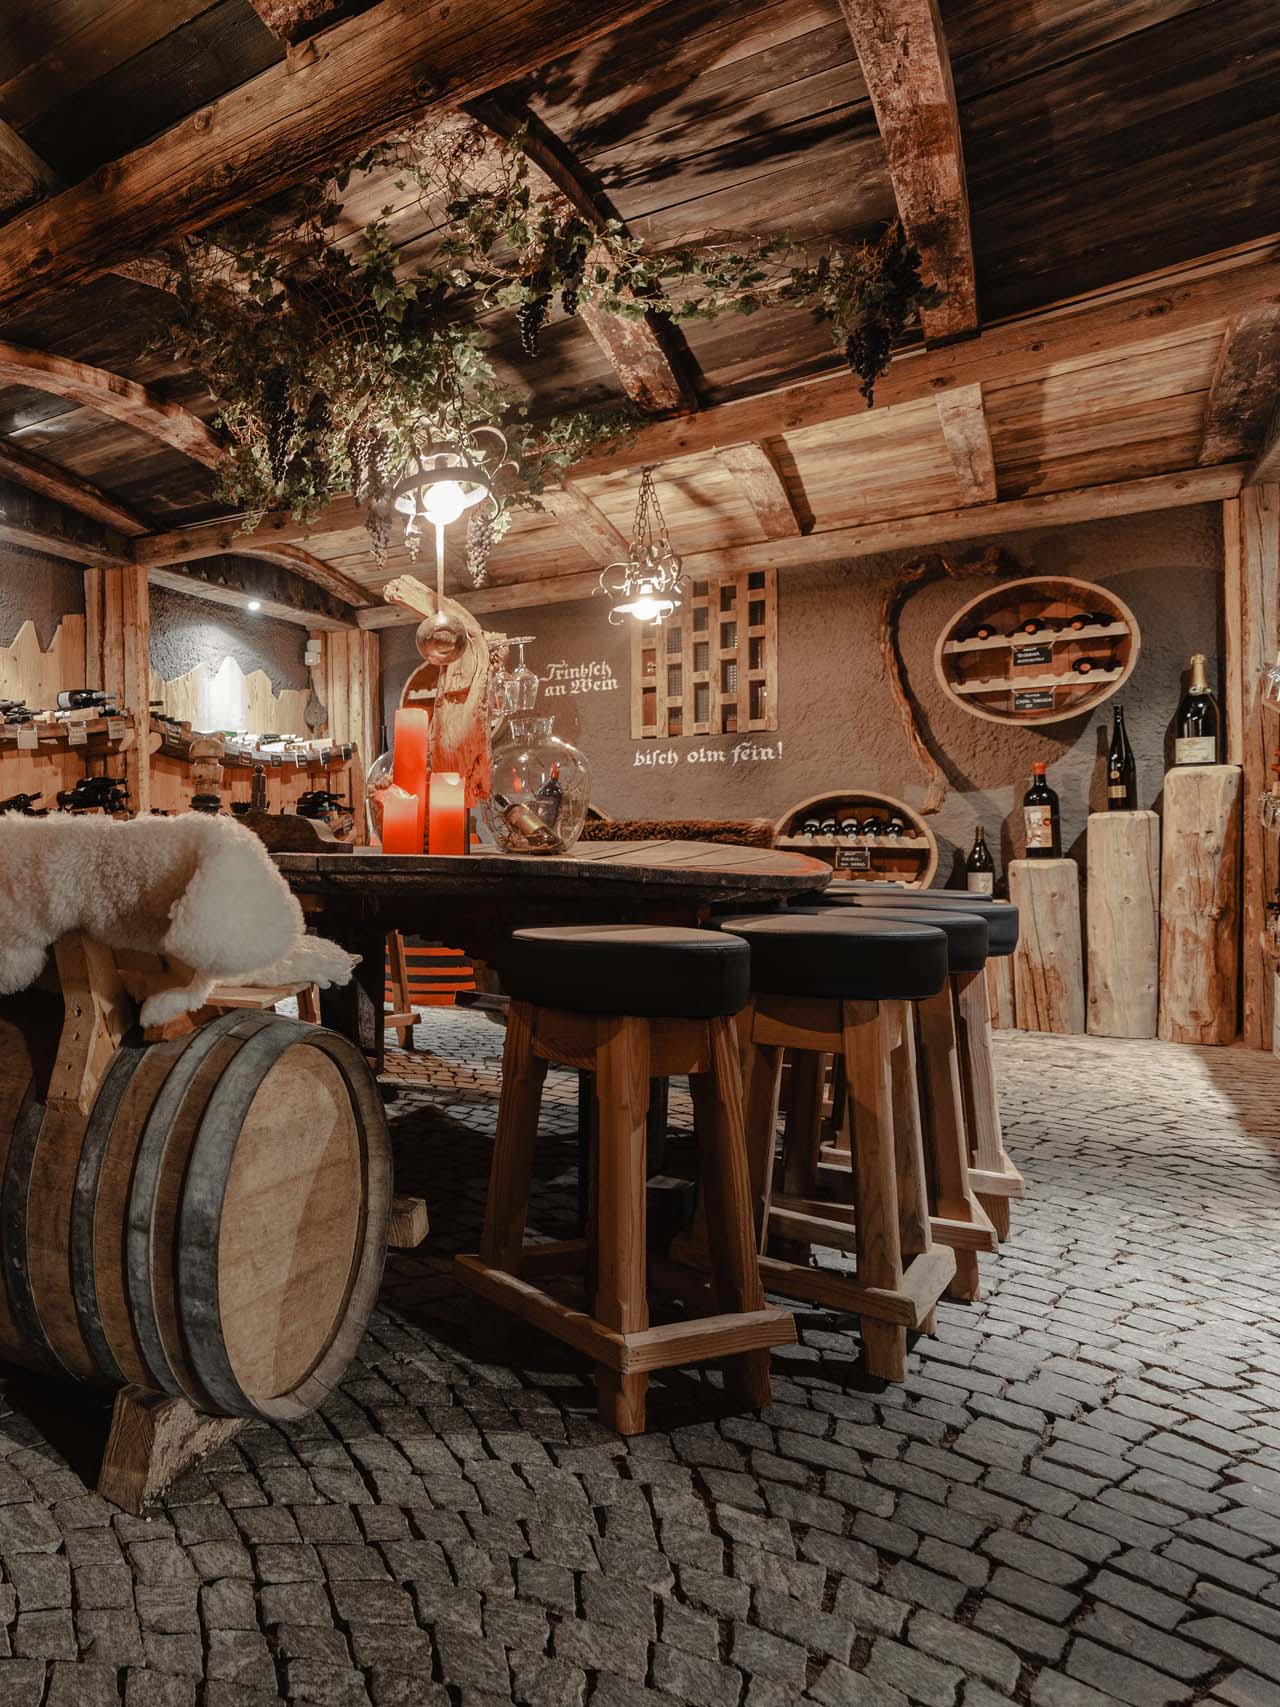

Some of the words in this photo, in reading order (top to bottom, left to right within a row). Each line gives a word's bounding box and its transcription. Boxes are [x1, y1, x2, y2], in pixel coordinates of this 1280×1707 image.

[544, 685, 568, 697] an
[570, 676, 619, 694] Wein
[687, 748, 726, 763] olm
[732, 741, 784, 767] fein!
